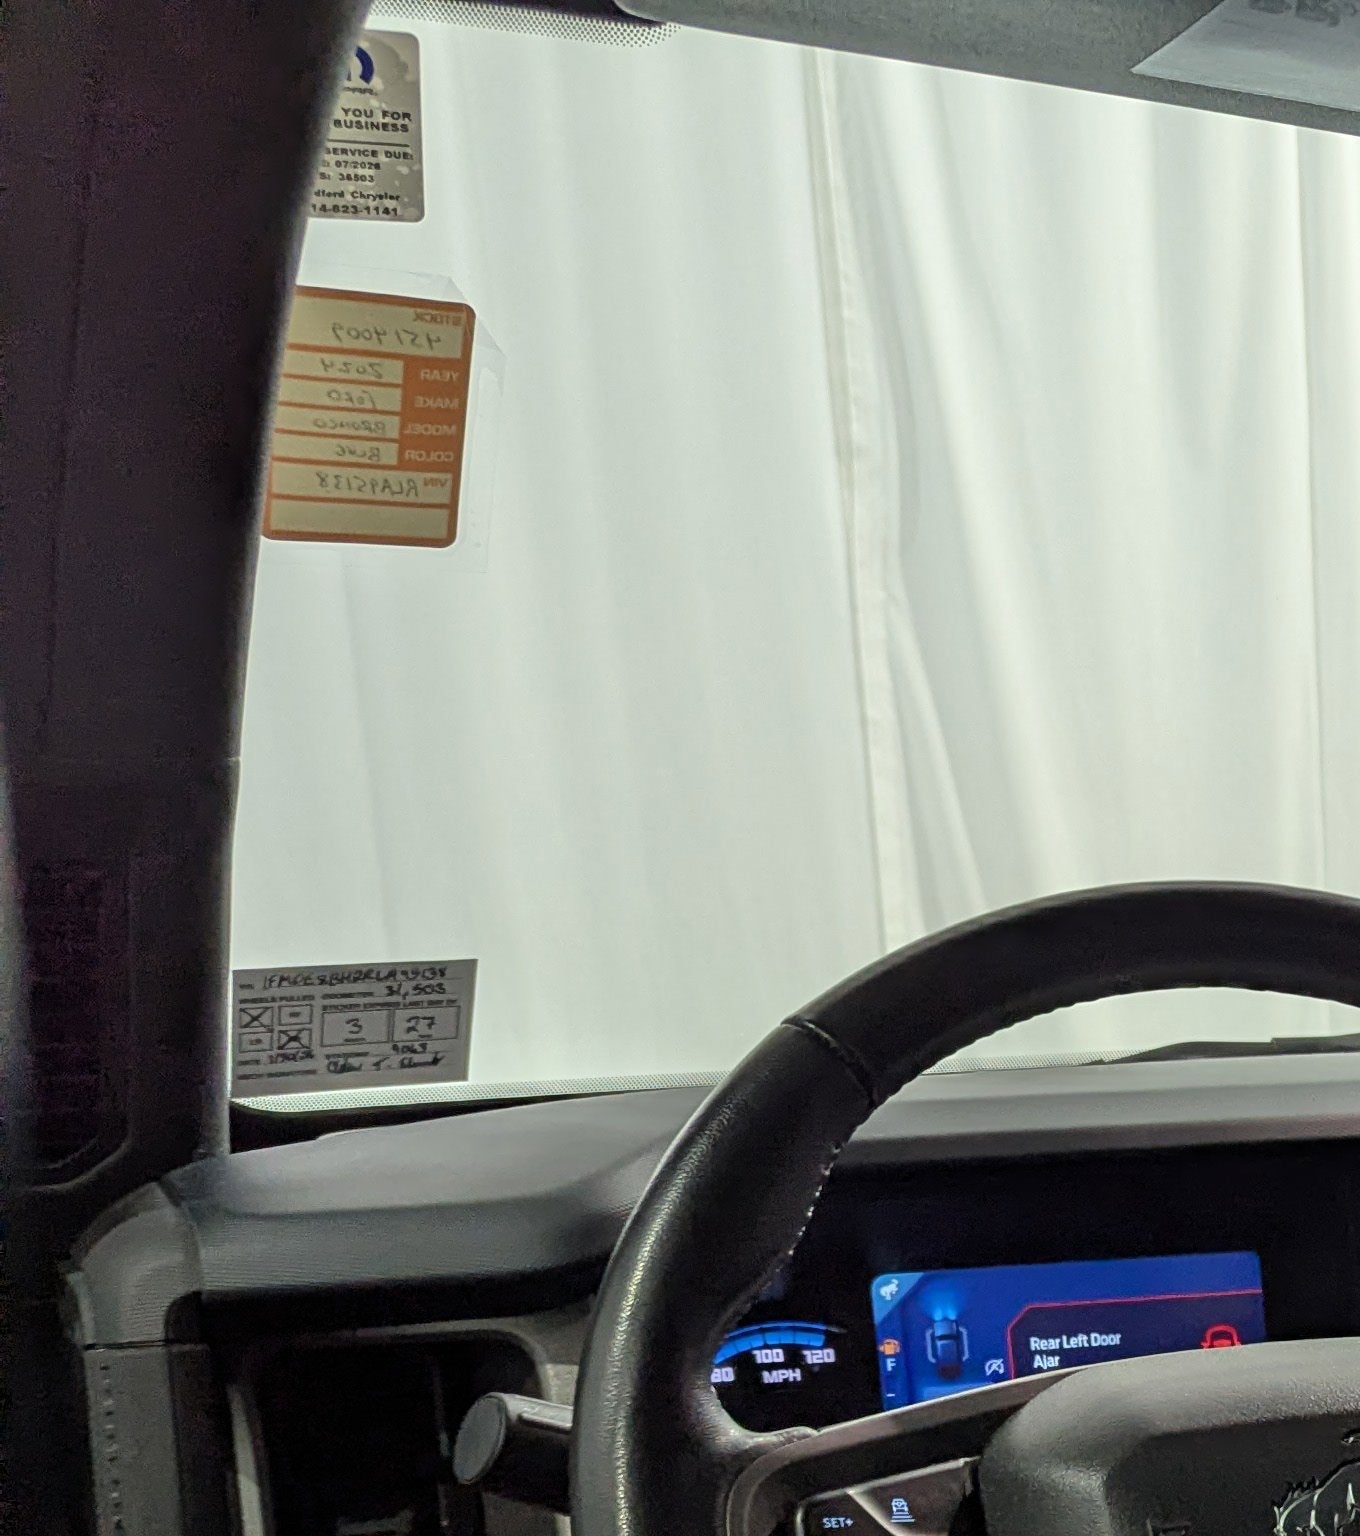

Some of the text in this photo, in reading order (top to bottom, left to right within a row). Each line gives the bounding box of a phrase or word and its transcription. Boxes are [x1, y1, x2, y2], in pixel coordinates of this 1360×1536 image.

[341, 107, 412, 121] YOU FOR
[334, 119, 409, 133] BUSINESS
[1029, 1332, 1122, 1351] Rear Left Door
[752, 1349, 836, 1365] 100 120
[1033, 1354, 1060, 1370] Ajar
[762, 1368, 802, 1384] MPH
